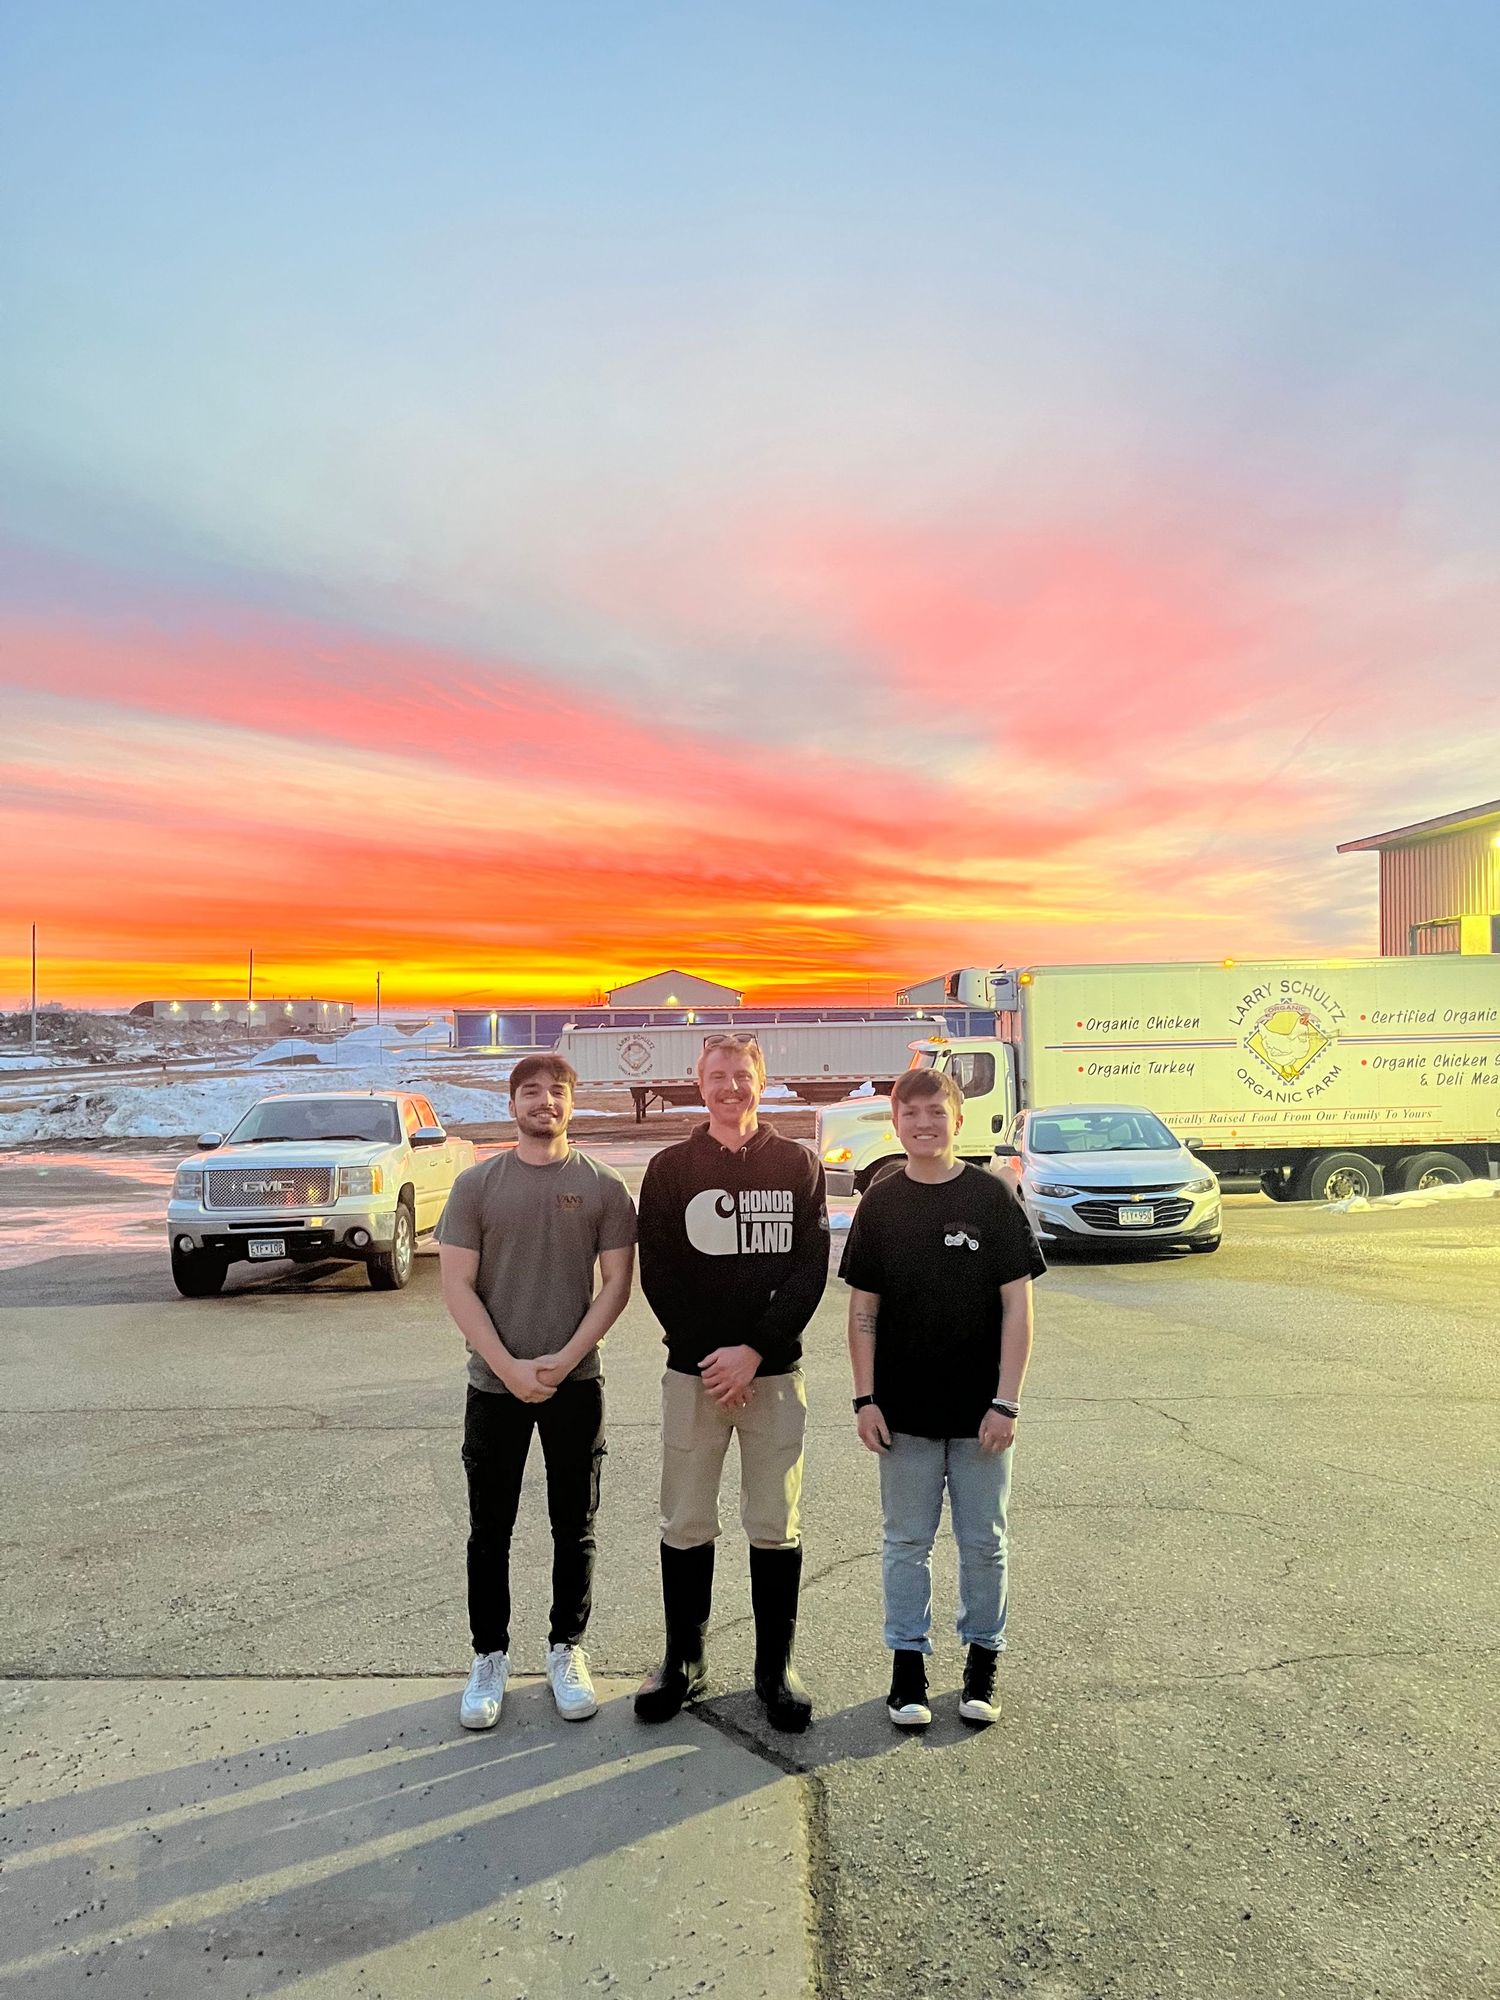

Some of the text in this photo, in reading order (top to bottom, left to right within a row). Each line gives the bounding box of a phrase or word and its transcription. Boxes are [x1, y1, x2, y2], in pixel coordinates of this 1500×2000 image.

[1229, 980, 1346, 1026] LARRY SCHULTZ
[1086, 1016, 1200, 1033] Organic Chicken
[1371, 1008, 1497, 1024] Certified Organic
[1087, 1061, 1195, 1078] Organic Turkey
[1372, 1054, 1427, 1071] Organic
[1433, 1054, 1487, 1068] Chicken
[1237, 1065, 1342, 1103] ORGANIC FARM
[1420, 1072, 1499, 1086] & Deli Mea
[1162, 1109, 1432, 1126] anically Raised Food From Our Family To Yours
[242, 1180, 294, 1193] GMC
[739, 1190, 793, 1212] HONOR
[740, 1213, 751, 1222] THE
[741, 1222, 793, 1254] LAND
